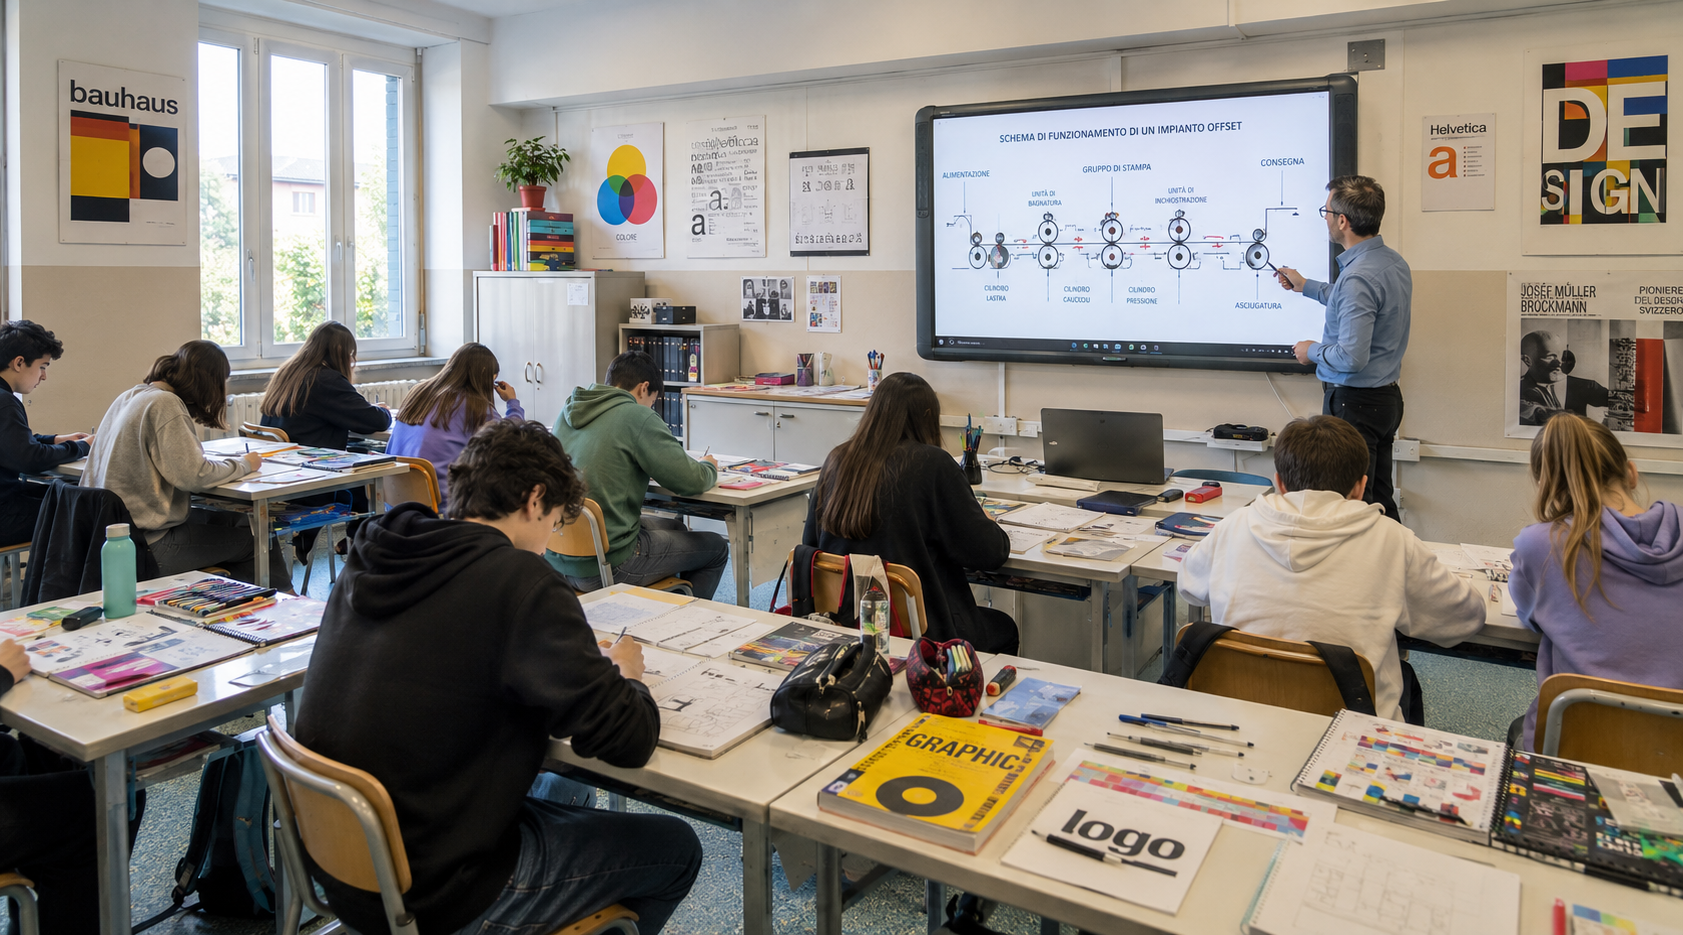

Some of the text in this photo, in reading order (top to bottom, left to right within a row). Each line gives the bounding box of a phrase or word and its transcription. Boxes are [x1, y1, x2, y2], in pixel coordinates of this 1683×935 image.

[70, 79, 178, 115] bauhaus
[1543, 81, 1667, 164] DE
[1000, 133, 1035, 143] SCHEMA
[1049, 128, 1126, 140] FUNZIONAMENTO
[1130, 127, 1138, 135] DI
[1142, 126, 1154, 135] UN
[1158, 124, 1204, 134] IMPIANTO
[1208, 122, 1242, 131] OFFSET
[1431, 123, 1486, 135] Helvetica
[1261, 158, 1304, 166] CONSEGNA
[1428, 146, 1458, 179] a
[942, 170, 989, 178] ALIMENTAZIONE
[1083, 164, 1152, 173] GRUPPO DI STAMPA
[1541, 168, 1662, 215] SIGN
[615, 233, 638, 241] COLORE
[1640, 286, 1683, 294] PIONIERE
[1235, 302, 1283, 310] ASCIUGATURA
[1640, 306, 1683, 315] SVIZZERO
[905, 733, 1020, 770] GRAPHIC
[1061, 808, 1185, 860] logo
